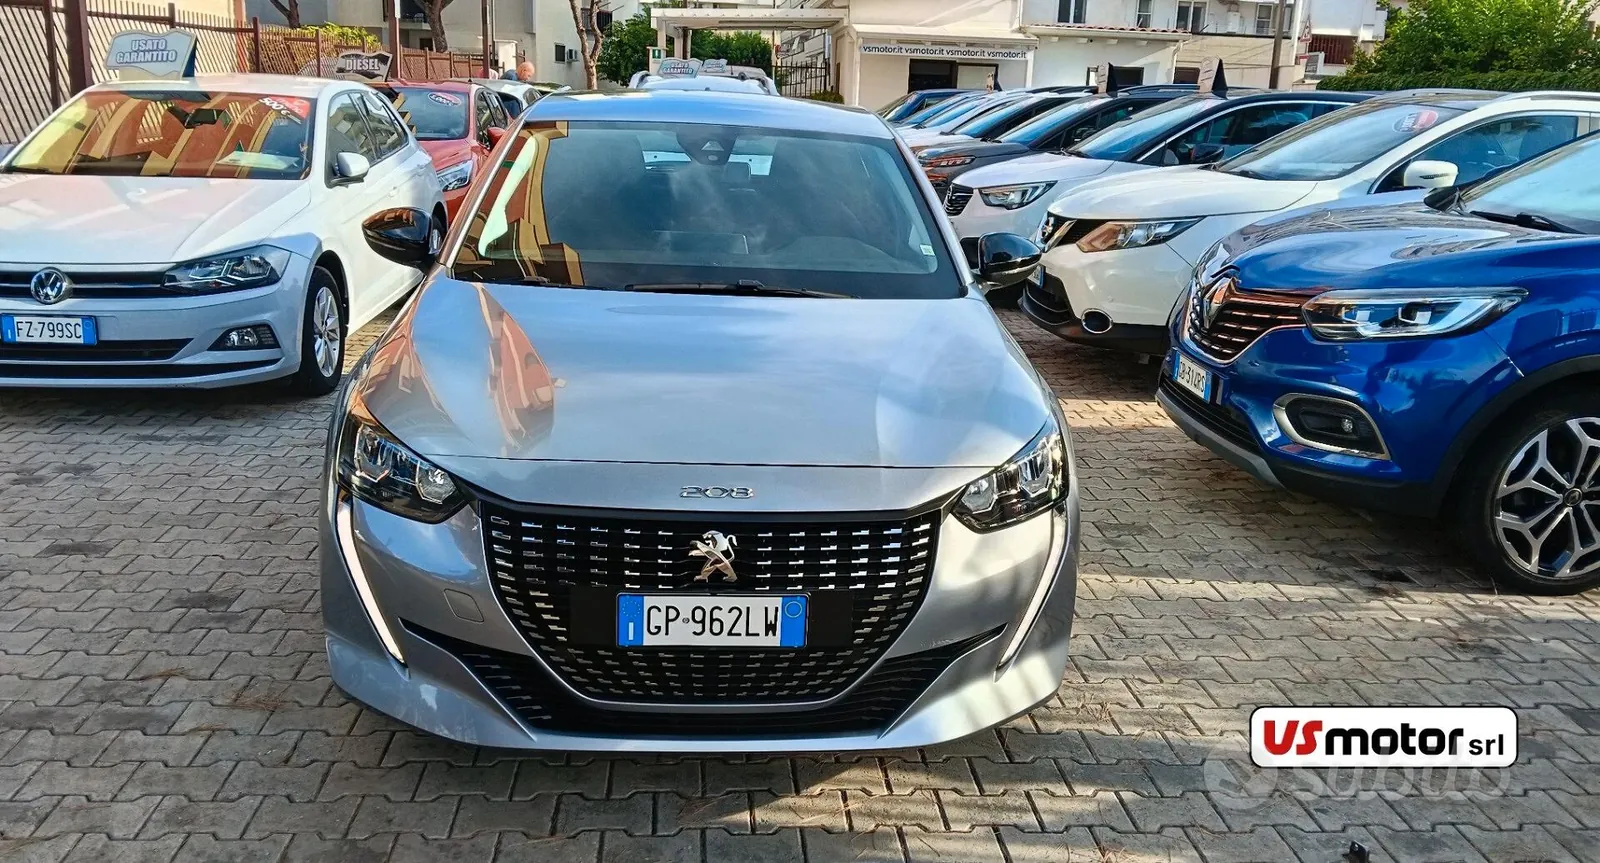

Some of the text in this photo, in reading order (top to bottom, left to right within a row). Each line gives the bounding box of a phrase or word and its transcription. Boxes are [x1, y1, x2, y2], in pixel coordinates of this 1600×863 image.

[131, 39, 167, 51] USATO
[116, 49, 177, 64] GARANTITO
[863, 45, 1027, 59] vsmotor.it vsmotor.it vsmotor.it vsmotor.it
[345, 58, 380, 71] DIESEL
[680, 486, 754, 499] 208
